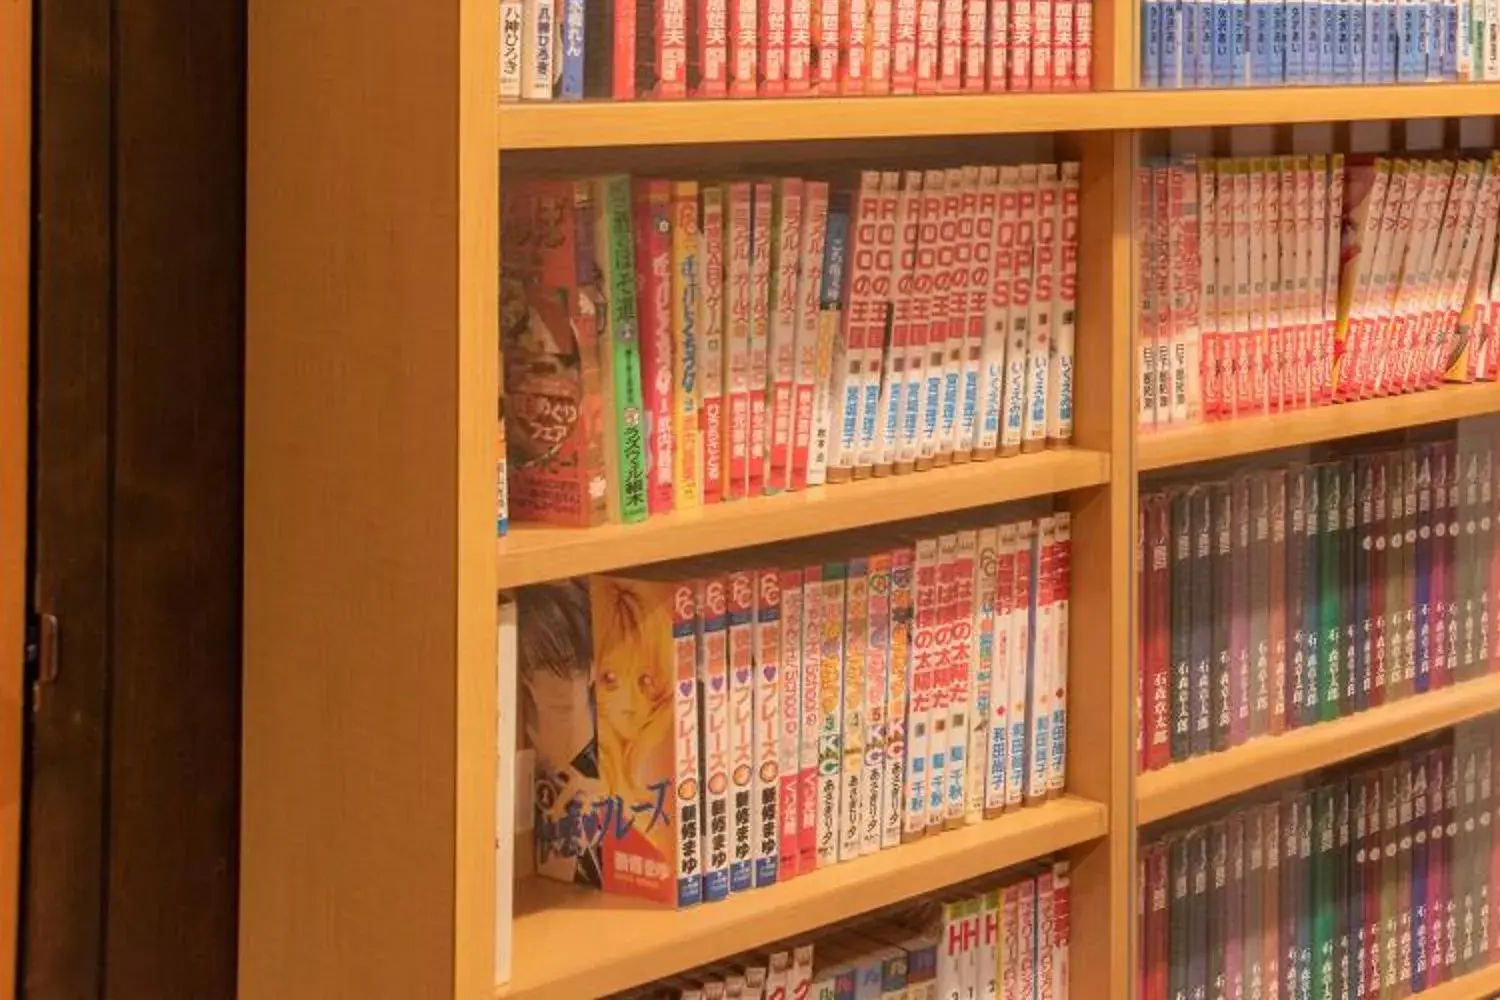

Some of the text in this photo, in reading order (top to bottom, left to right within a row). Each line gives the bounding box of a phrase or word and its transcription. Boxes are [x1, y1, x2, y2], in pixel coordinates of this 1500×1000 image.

[992, 193, 1016, 307] POPS
[1013, 191, 1034, 306] POPS
[1035, 188, 1055, 302] POPS
[1060, 188, 1078, 300] POPS
[912, 758, 925, 809] 千秋
[932, 753, 944, 805] 千秋
[949, 746, 962, 800] 千秋
[962, 919, 979, 952] H
